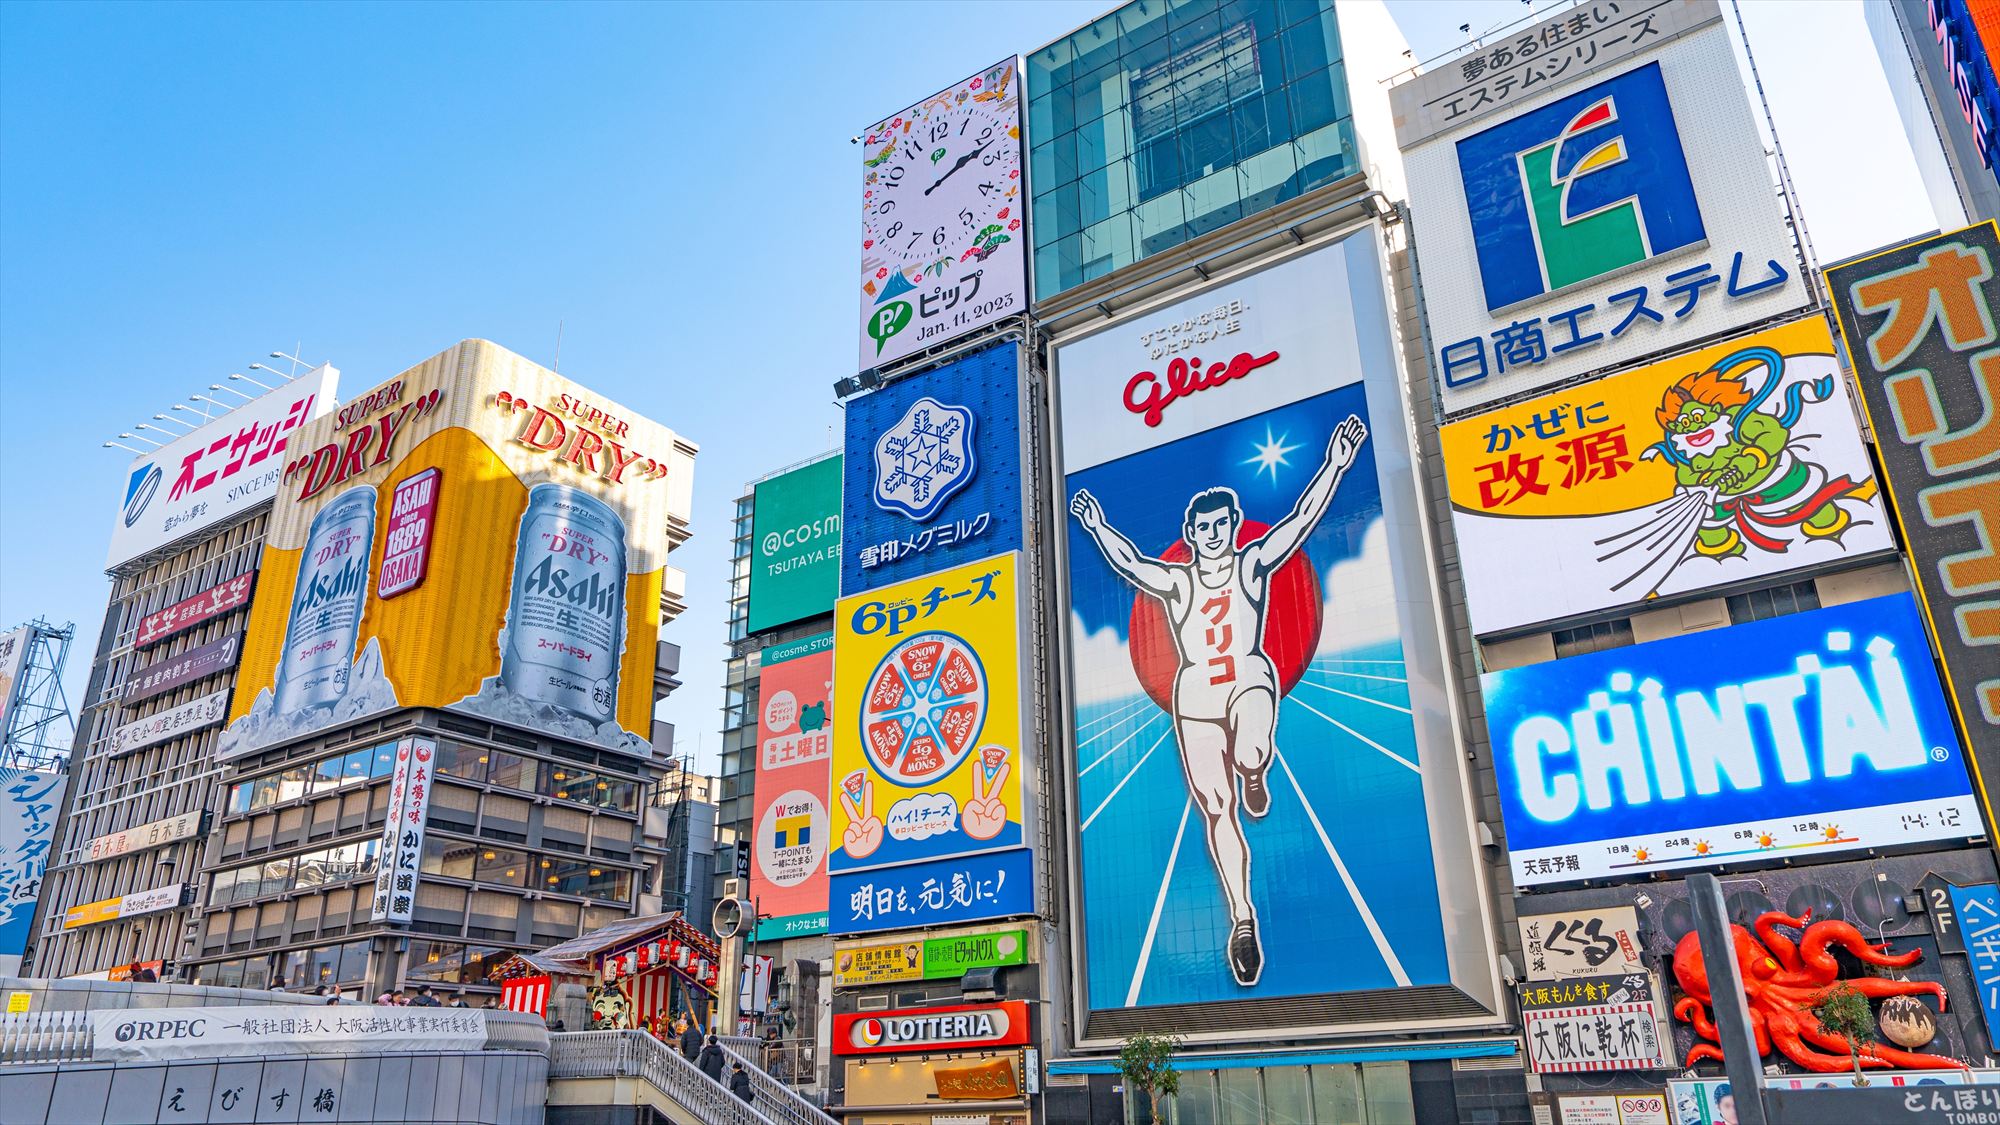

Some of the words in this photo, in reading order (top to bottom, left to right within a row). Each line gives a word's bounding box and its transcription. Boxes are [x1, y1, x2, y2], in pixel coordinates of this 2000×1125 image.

[1461, 2, 1620, 82] 夢ある住まい
[1443, 13, 1659, 121] エステムシリーズ
[928, 122, 949, 143] 12
[959, 117, 970, 136] 1
[974, 127, 992, 146] 2
[904, 140, 923, 161] 11
[982, 150, 1001, 167] 3
[885, 166, 905, 191] 10
[977, 180, 994, 197] 4
[879, 199, 896, 215] 9
[958, 207, 974, 226] 5
[886, 220, 903, 239] 8
[907, 231, 922, 249] 7
[932, 226, 946, 245] 6
[919, 269, 984, 319] ピップ
[916, 317, 950, 342] Jan.
[973, 291, 1014, 318] 2023
[1442, 251, 1789, 388] 日商エステム
[1151, 319, 1241, 360] ゆたかな人生
[334, 380, 402, 432] SUPER
[555, 393, 631, 440] SUPER
[1482, 400, 1610, 454] かぜに
[1474, 424, 1634, 510] 改源
[227, 477, 261, 503] SINCE
[263, 469, 280, 487] 193
[392, 477, 433, 518] ASAHI
[399, 510, 420, 526] since
[328, 527, 351, 543] SUPER
[386, 524, 425, 559] 1889
[562, 527, 594, 545] SUPER
[762, 513, 840, 557] @cosm
[859, 512, 990, 569] 雪印メグミルク
[379, 552, 421, 591] OSAKA
[768, 551, 824, 576] TSUTAYA
[297, 555, 363, 618] Asahi
[525, 554, 615, 620] Asahi
[315, 609, 332, 631] 生
[557, 608, 579, 632] 生
[299, 639, 337, 661] スーパードライ
[538, 638, 592, 663] スーパードライ
[771, 644, 808, 661] @cosme
[810, 637, 834, 652] STOR
[1200, 588, 1236, 687] グリコ
[908, 644, 937, 660] SNOW
[953, 656, 975, 686] SNOW
[125, 678, 141, 698] 7F
[873, 671, 892, 706] SNOW
[954, 710, 974, 747] SNOW
[1512, 632, 1928, 822] CHINTAI
[780, 734, 828, 762] 土曜日
[873, 729, 891, 760] SNOW
[906, 758, 937, 773] SNOW
[408, 766, 427, 825] 本場の味
[149, 818, 187, 844] 白木屋
[1734, 830, 1753, 841] 6時
[1792, 822, 1819, 833] 12時
[1606, 844, 1630, 856] 18時
[1665, 837, 1691, 848] 24時
[374, 830, 396, 914] かに道楽
[392, 830, 419, 914] かに道楽
[1523, 854, 1581, 877] 天気予報
[1527, 921, 1547, 972] 道頓堀
[1544, 917, 1618, 967] くくる
[1522, 981, 1611, 1006] 大阪もんを食す
[1632, 988, 1648, 1001] 2F
[222, 1017, 331, 1035] 一般社団法人
[888, 1014, 995, 1041] LOTTERIA
[1534, 1015, 1640, 1061] 大阪に乾杯
[1642, 1019, 1655, 1048] 検索
[168, 1087, 335, 1113] えびす橋
[1946, 1113, 2000, 1125] TOMBO
